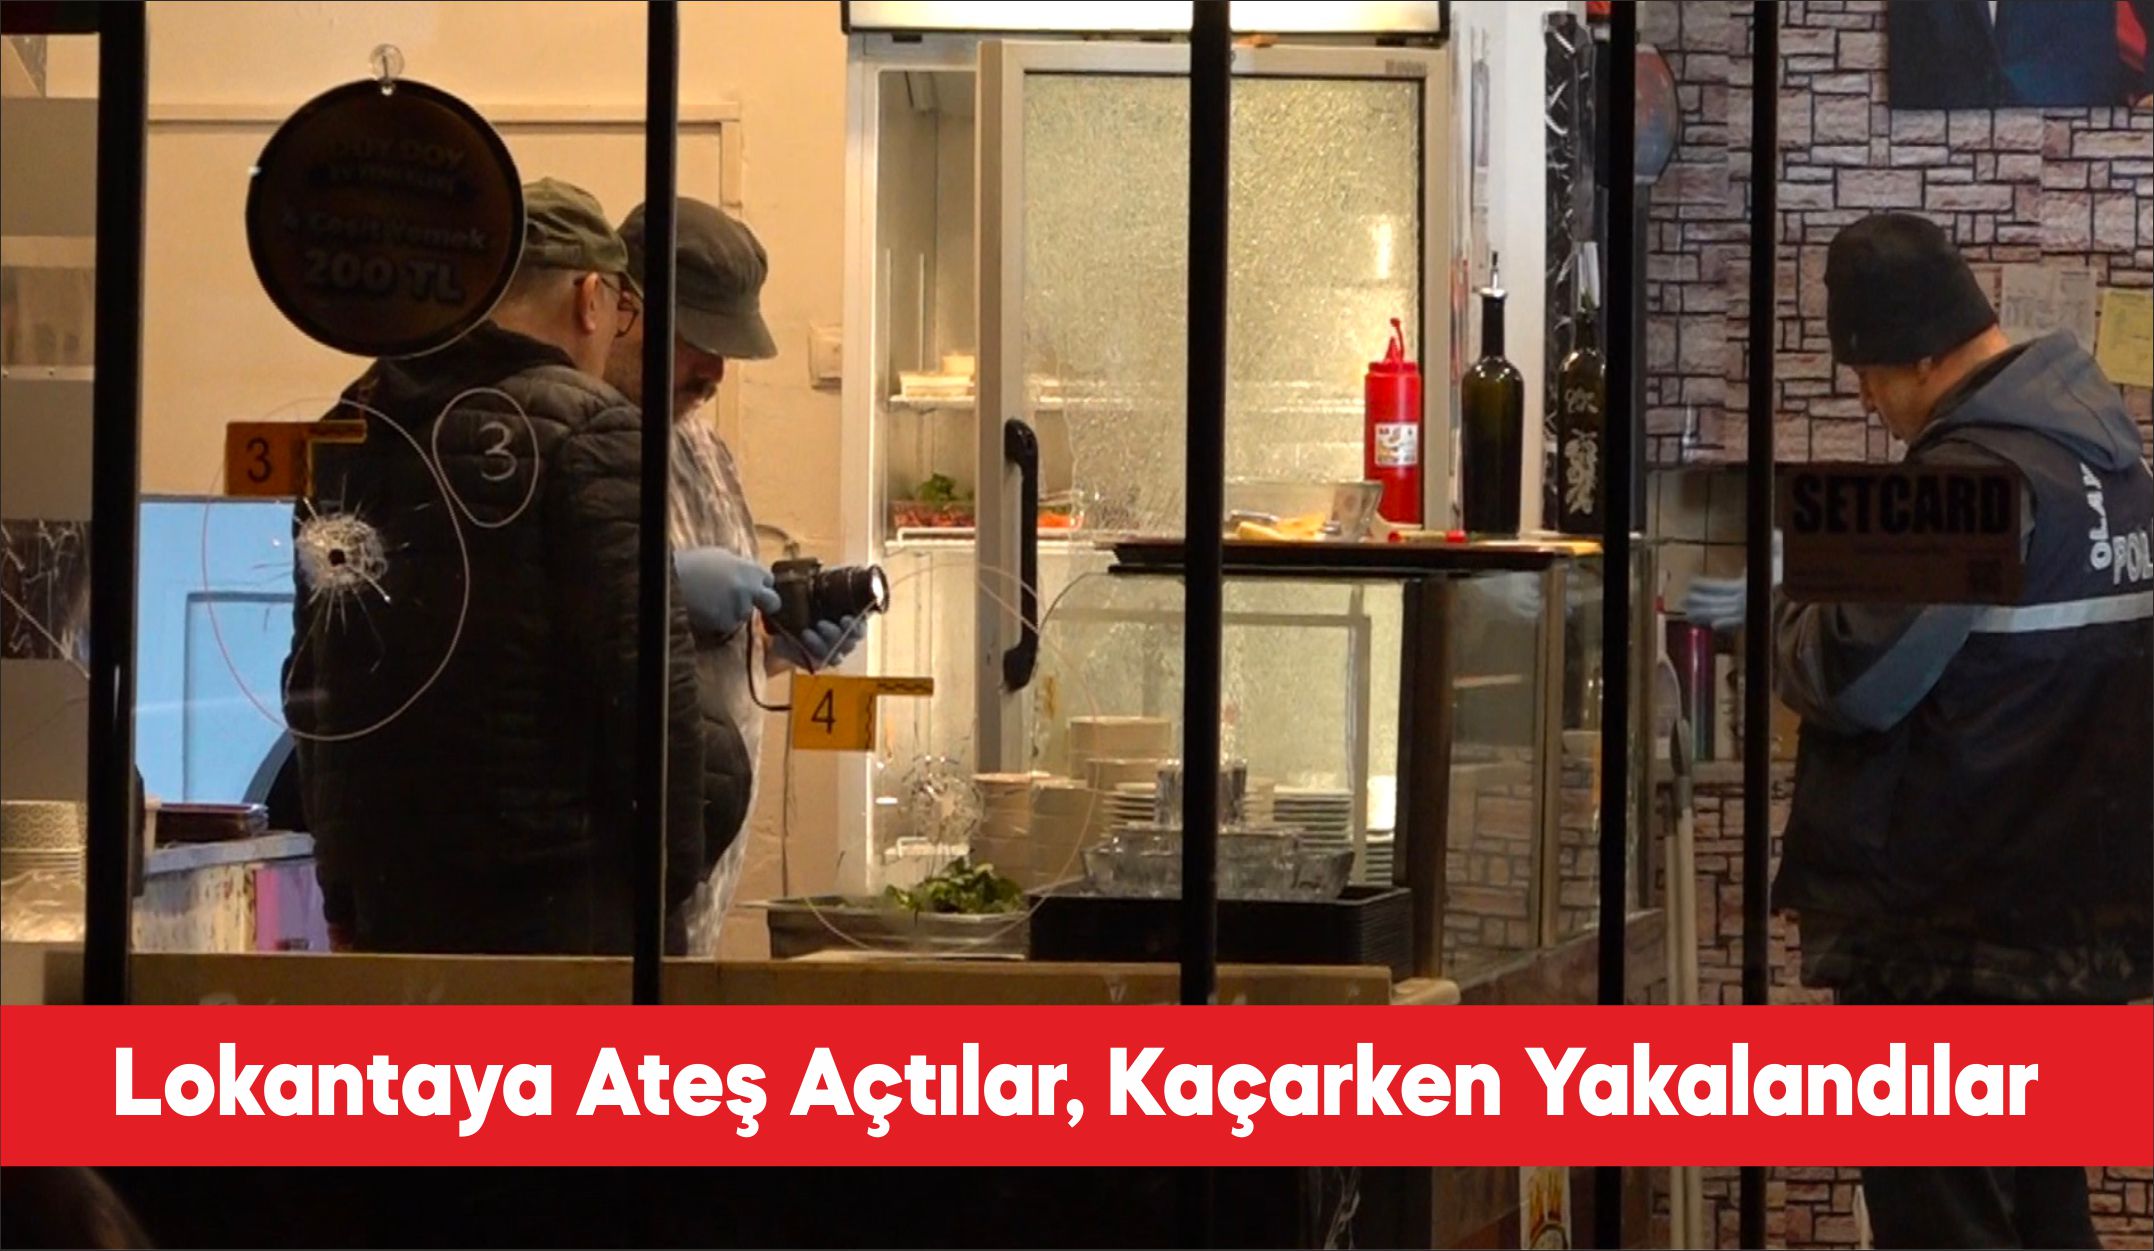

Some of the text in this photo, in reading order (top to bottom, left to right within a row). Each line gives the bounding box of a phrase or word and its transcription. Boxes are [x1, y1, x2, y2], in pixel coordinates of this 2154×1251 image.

[304, 251, 465, 302] 200 TL
[246, 437, 271, 484] 3
[478, 421, 518, 481] 3
[1792, 473, 2013, 536] SETCARD
[810, 688, 837, 735] 4
